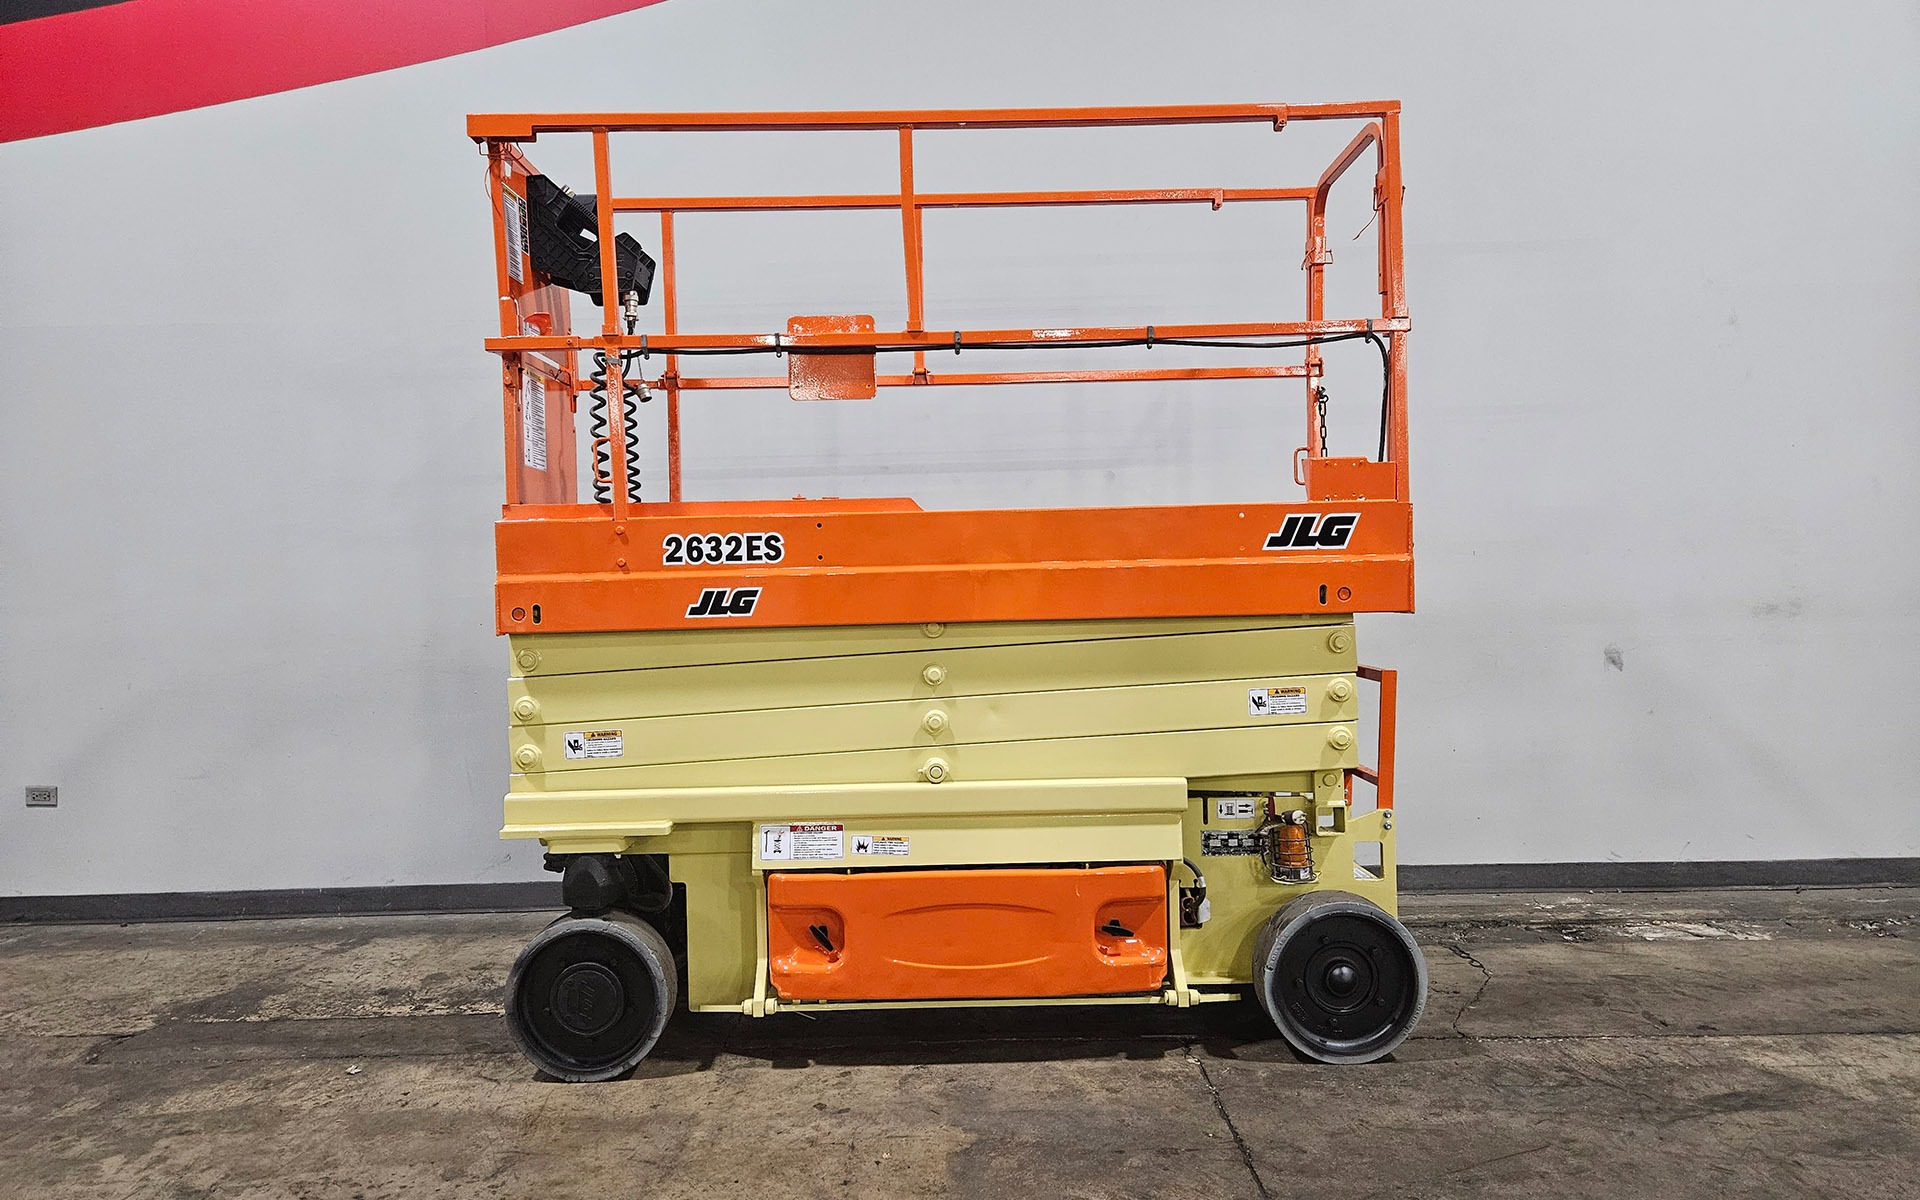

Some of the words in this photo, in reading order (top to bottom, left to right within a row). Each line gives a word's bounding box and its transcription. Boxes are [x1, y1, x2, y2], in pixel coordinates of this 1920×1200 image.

[1265, 515, 1358, 548] JLG
[665, 534, 782, 563] 2632ES
[687, 589, 760, 616] JLG
